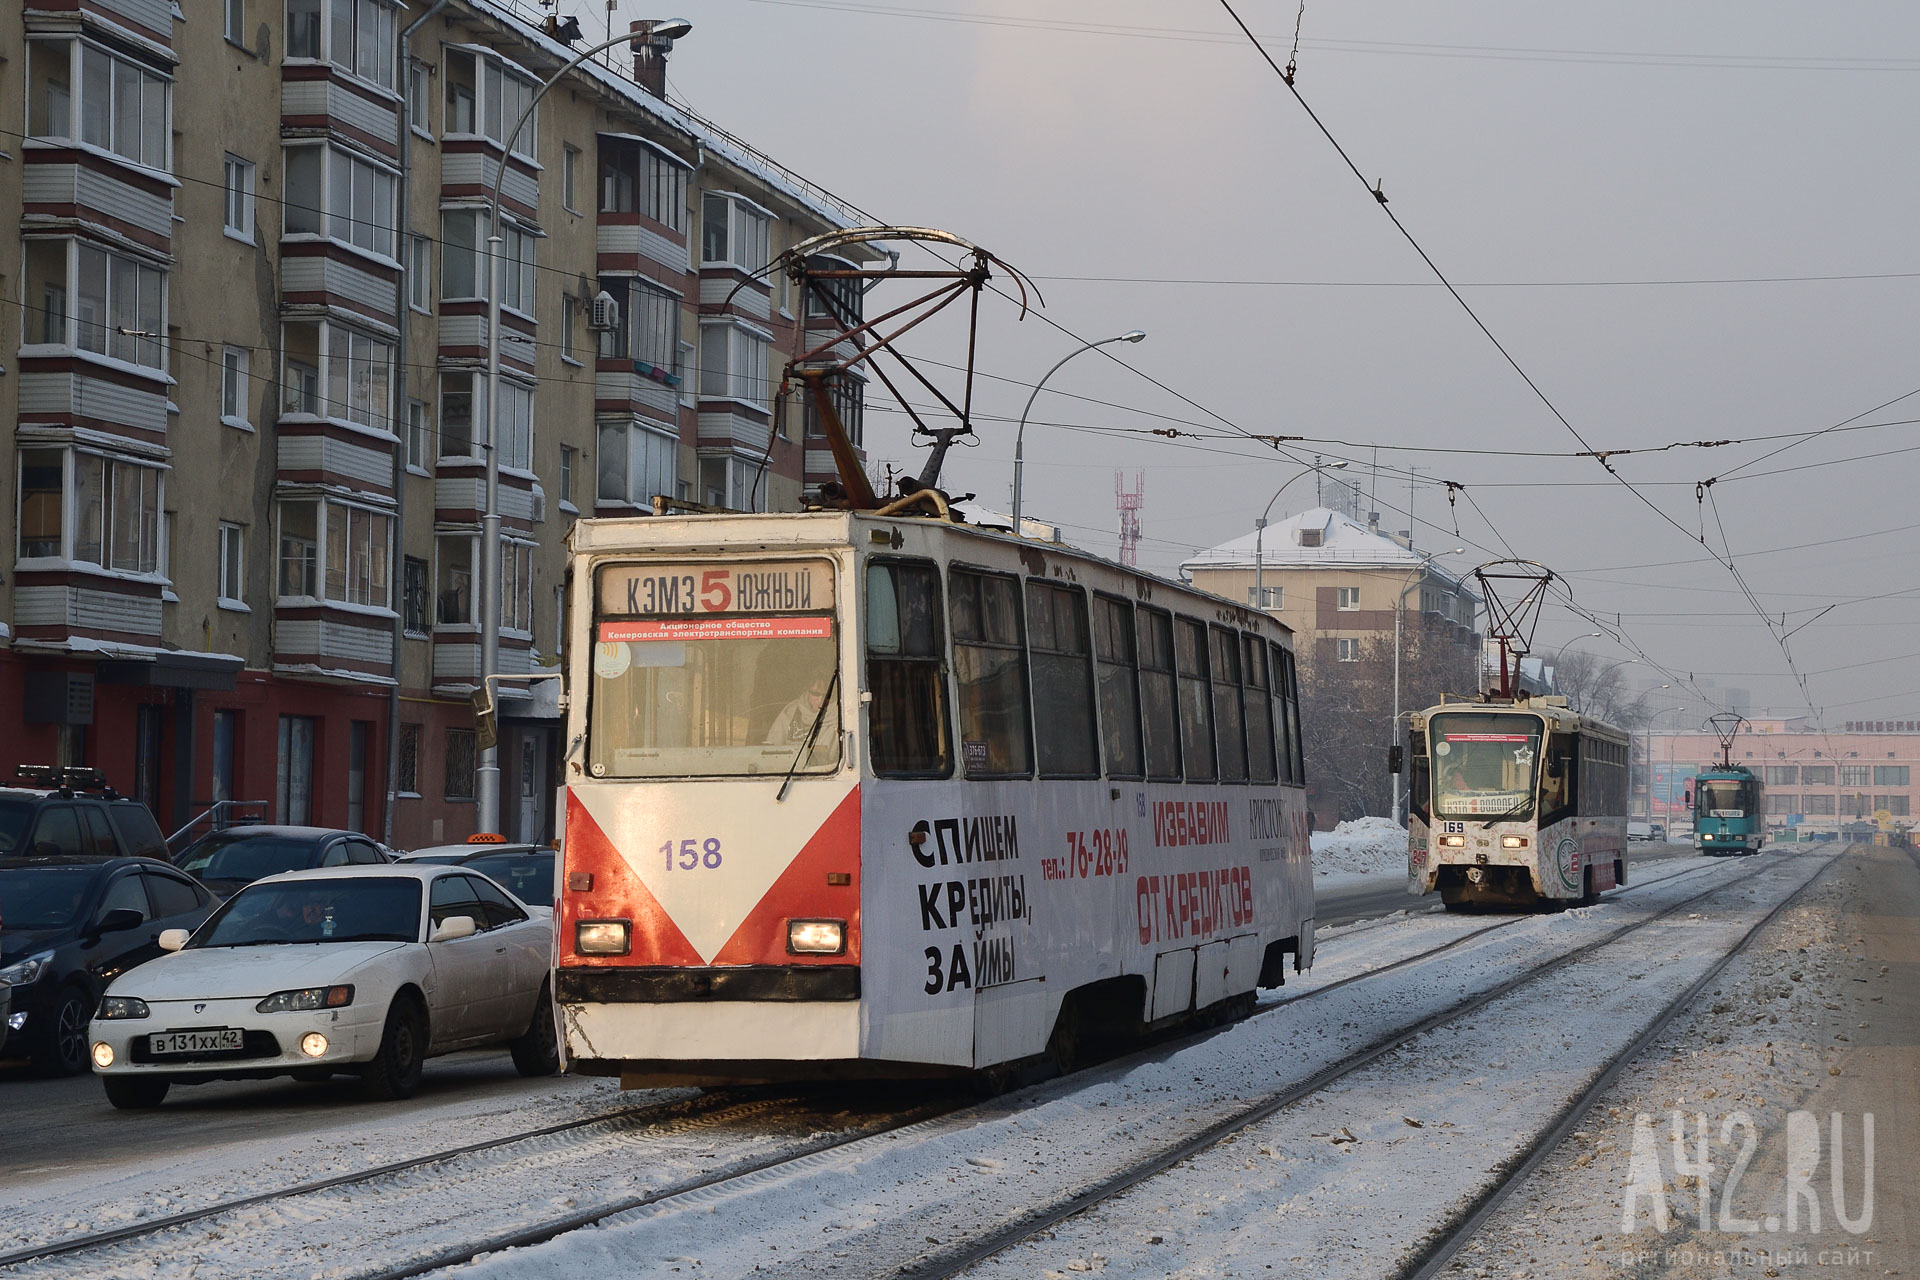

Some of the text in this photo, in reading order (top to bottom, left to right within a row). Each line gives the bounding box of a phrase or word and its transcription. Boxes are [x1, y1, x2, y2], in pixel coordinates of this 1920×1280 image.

[627, 568, 811, 613] КЭМЗ 5 ЮЖНЫЙ
[608, 628, 823, 640] Кемеровская электротранспортная компания
[660, 621, 771, 631] Акционерное общество
[909, 815, 1019, 868] СПИШЕМ
[1153, 800, 1230, 847] ИЗБАВИМ
[1443, 822, 1464, 833] 169
[659, 837, 723, 872] 158
[1066, 828, 1129, 879] 76-28-29
[918, 874, 1032, 932] КРЕДИТЫ,
[1136, 866, 1254, 946] ОТ КРЕДИТОВ
[924, 930, 1016, 995] ЗАЙМЫ
[221, 1031, 238, 1044] 42
